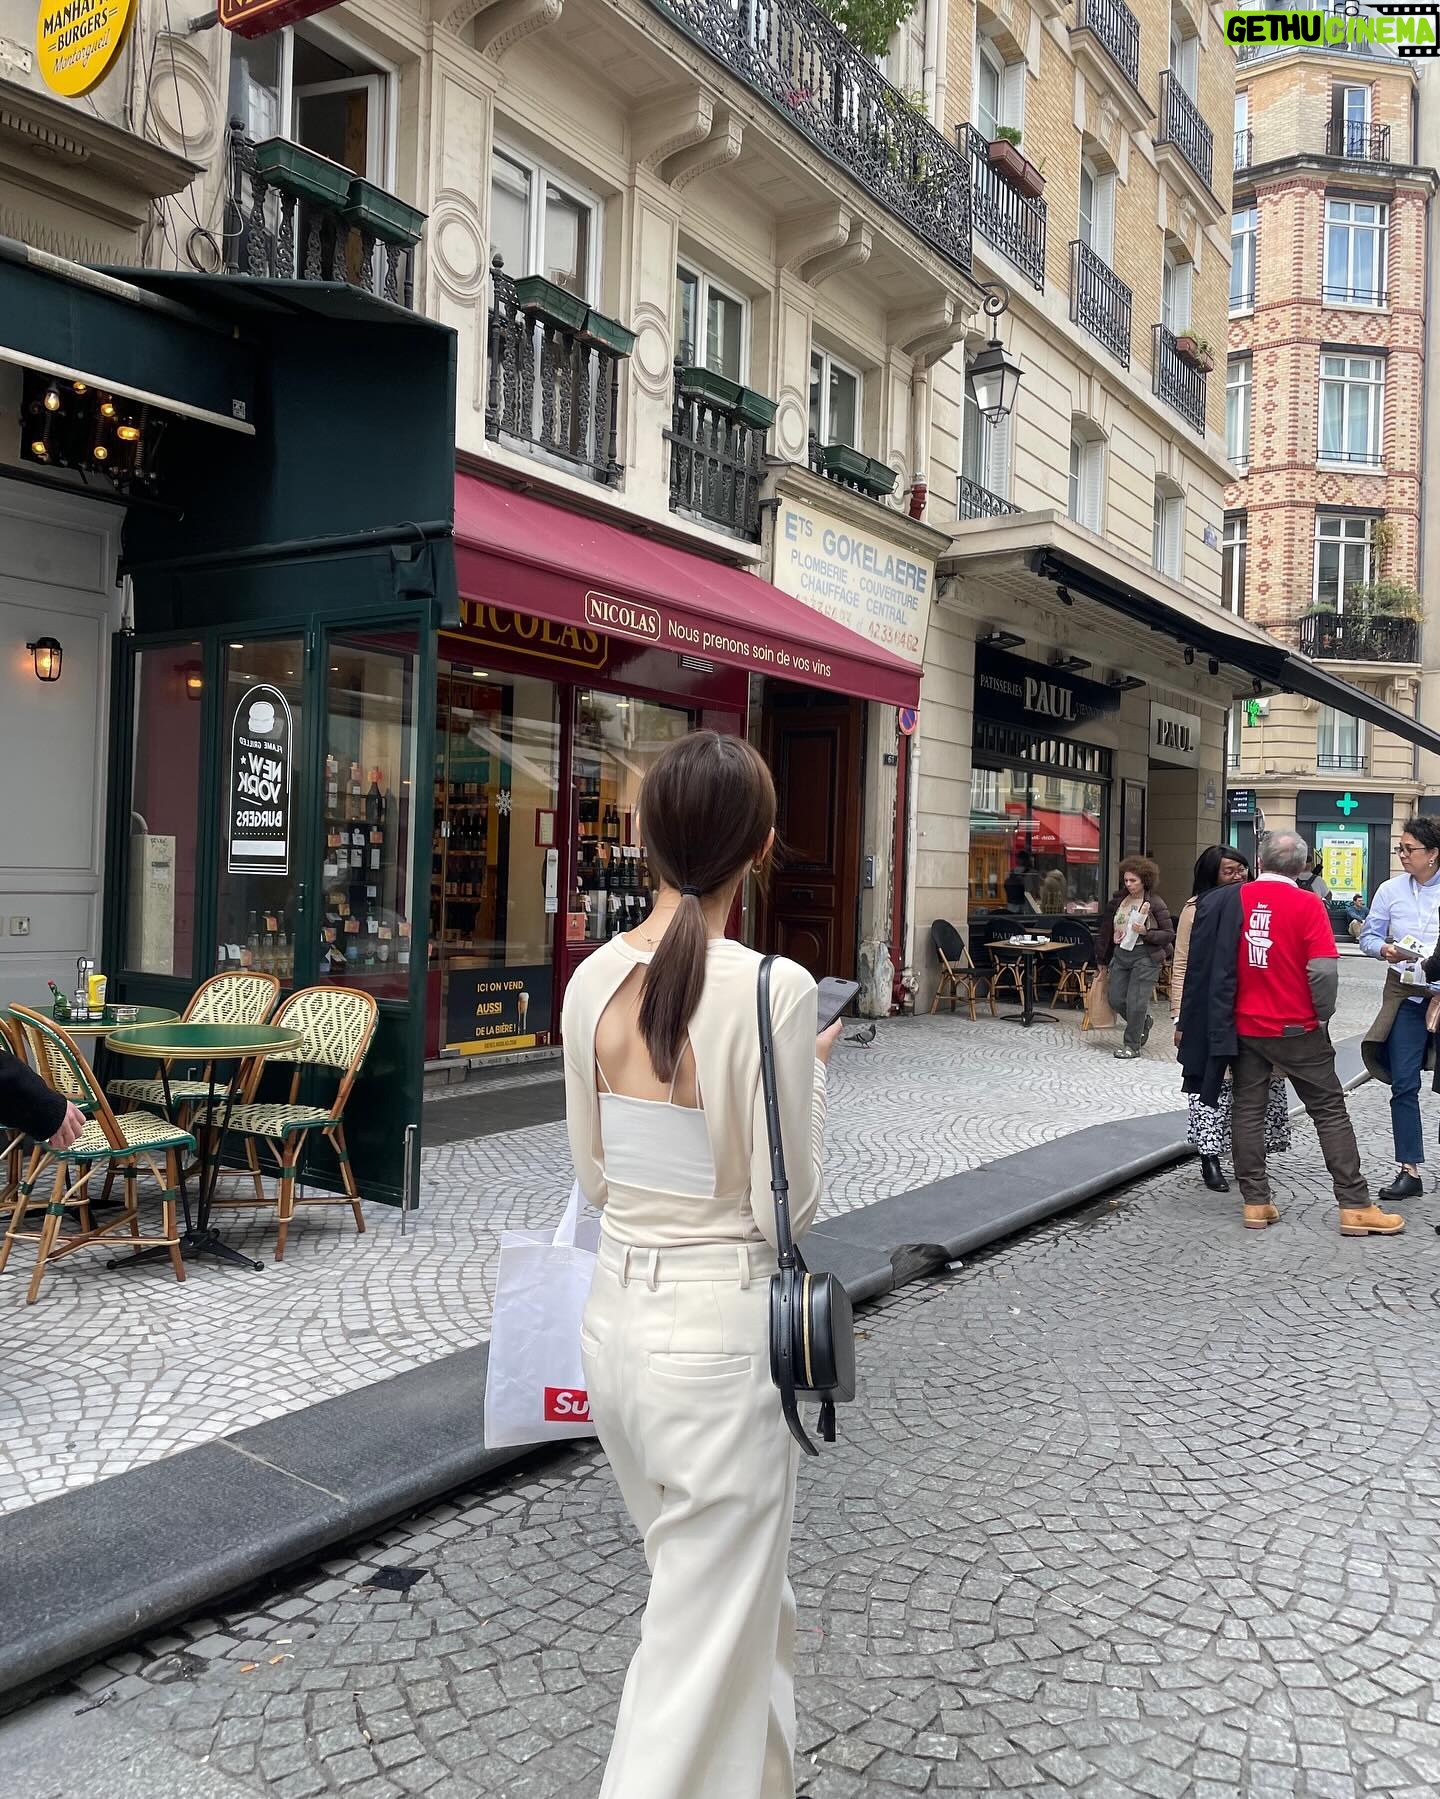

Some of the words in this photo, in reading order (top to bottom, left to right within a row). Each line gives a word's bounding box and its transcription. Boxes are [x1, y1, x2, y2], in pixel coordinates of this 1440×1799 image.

[44, 0, 107, 38] MANHA
[57, 7, 108, 52] BURGERS
[822, 528, 927, 593] GOKELAERE
[791, 549, 848, 584] PLOMBERIE
[859, 576, 919, 611] COUVERTURE
[800, 572, 860, 608] CHAUFFAGE
[866, 599, 907, 626] CENTRAL
[590, 598, 656, 634] NICOLAS
[668, 619, 700, 643] Nous
[703, 631, 750, 656] prenons
[752, 644, 775, 663] soin
[776, 649, 790, 666] de
[792, 656, 810, 671] vos
[812, 658, 831, 677] vins
[980, 673, 1023, 698] PATISSERIES
[1024, 676, 1077, 721] PAUL
[1156, 718, 1195, 752] PAUL
[1249, 912, 1272, 930] GIVE
[1248, 943, 1269, 966] LIVE
[477, 984, 488, 992] ICI
[490, 983, 501, 991] ON
[503, 981, 523, 990] VEND
[476, 1002, 502, 1014] AUSSI
[476, 1027, 485, 1036] DE
[486, 1026, 494, 1035] LA
